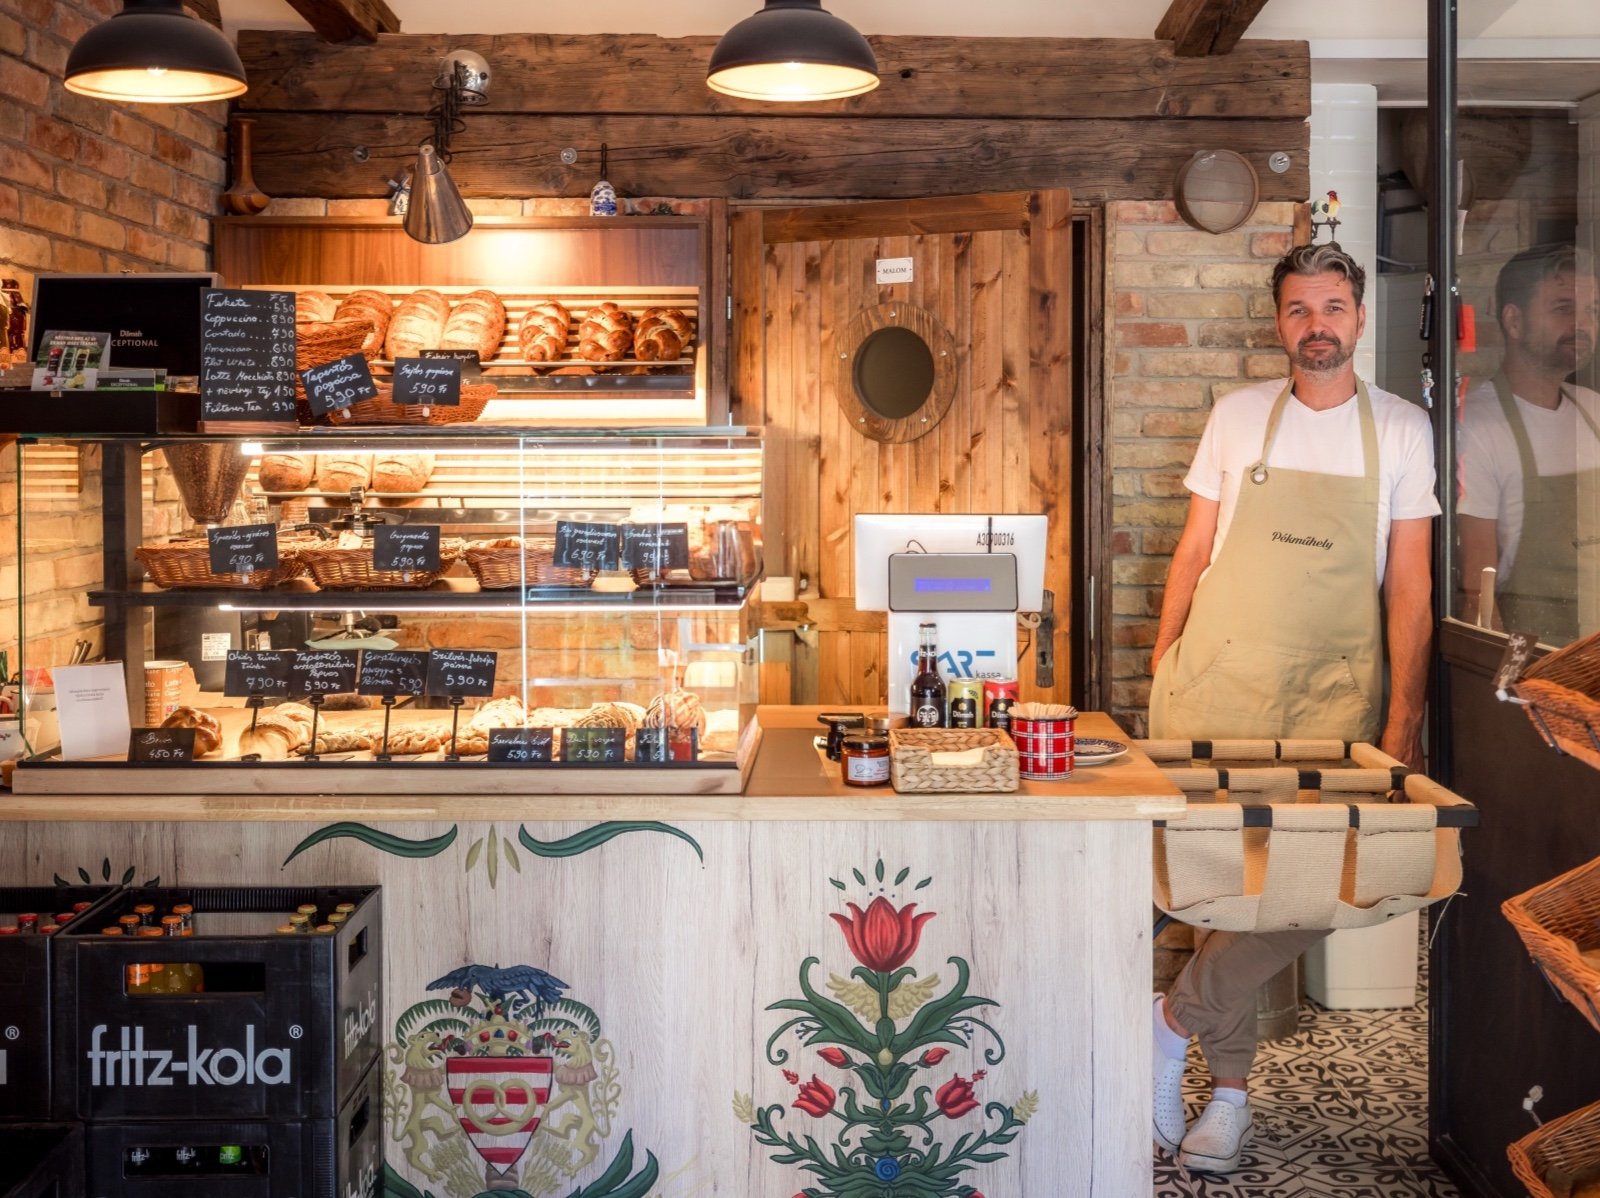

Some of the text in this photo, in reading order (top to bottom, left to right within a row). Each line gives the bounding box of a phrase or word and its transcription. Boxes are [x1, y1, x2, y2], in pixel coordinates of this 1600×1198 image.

[207, 293, 252, 308] Fekete
[271, 314, 295, 325] 890
[271, 327, 295, 340] 790
[273, 343, 295, 354] 650
[270, 355, 295, 368] 890
[205, 368, 232, 381] Latte
[275, 371, 296, 381] 890
[274, 384, 296, 397] 150
[409, 382, 437, 394] 590
[325, 388, 356, 408] 590
[272, 402, 296, 412] 390
[1271, 531, 1334, 550] Pékműhely
[229, 554, 252, 565] 690
[571, 549, 594, 561] 690
[391, 556, 414, 567] 590
[445, 674, 475, 686] 590
[975, 670, 1001, 679] kassa
[246, 676, 275, 690] 790
[304, 680, 329, 691] 590
[400, 677, 423, 692] 590
[953, 710, 974, 718] Dilmah
[149, 749, 170, 759] 450
